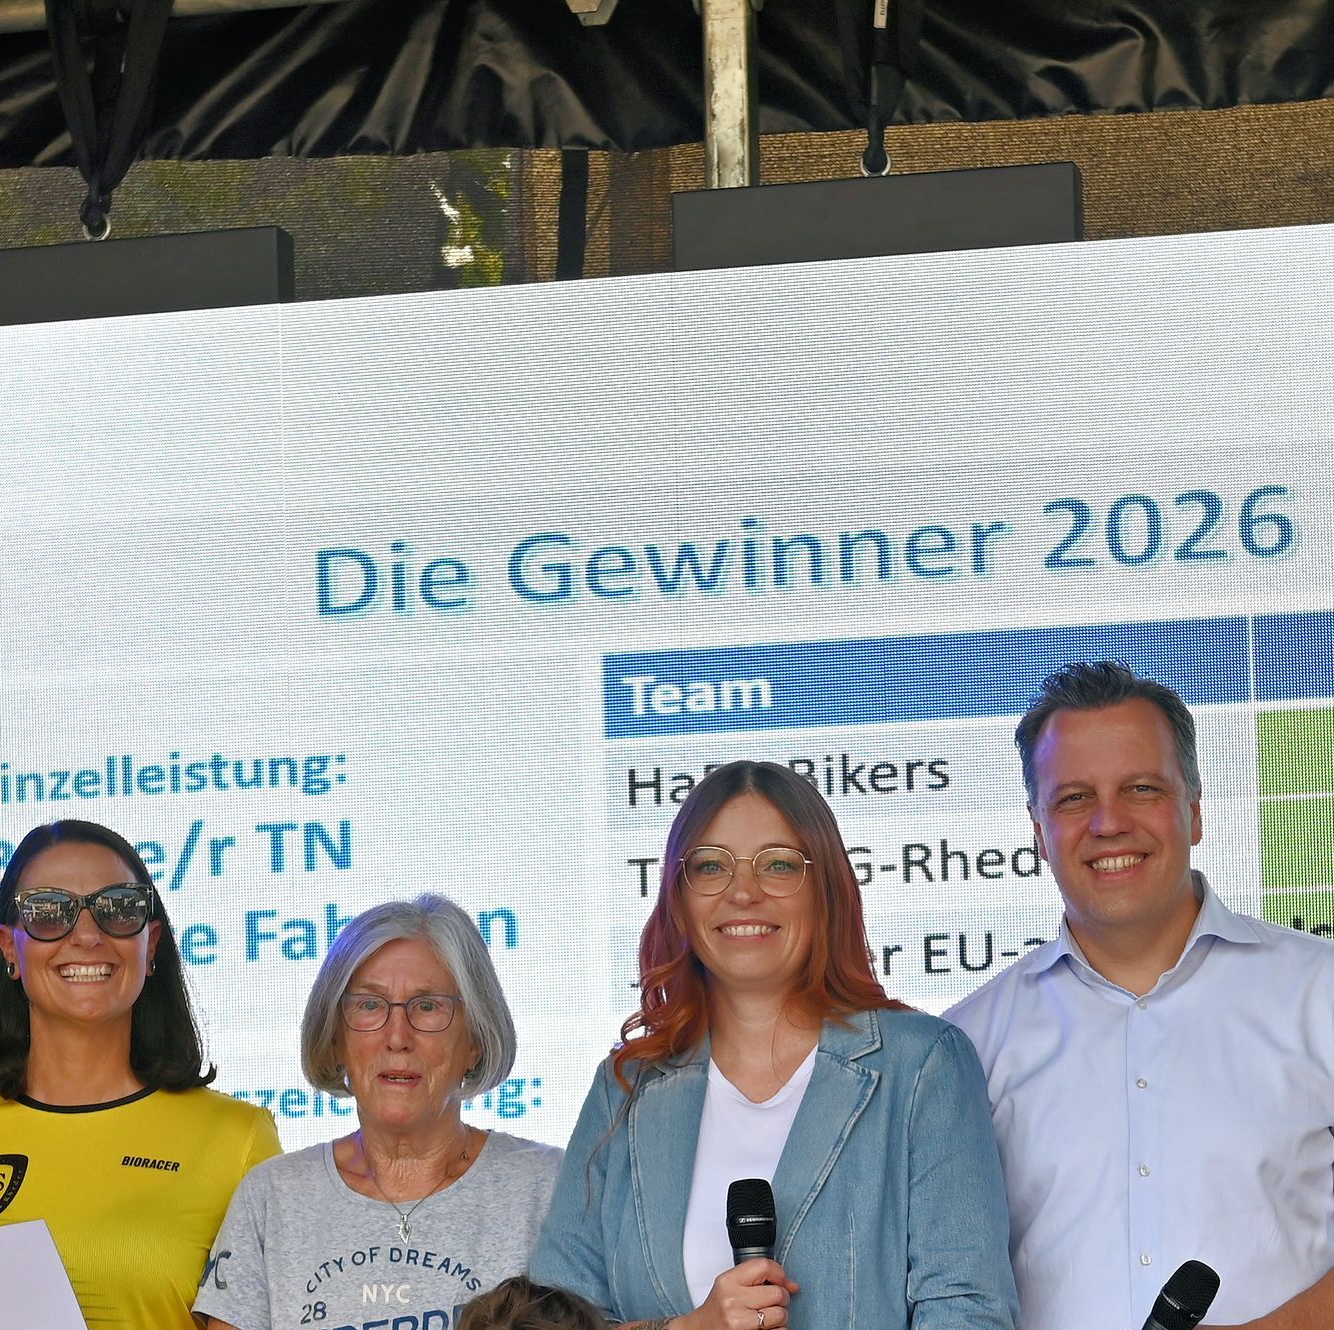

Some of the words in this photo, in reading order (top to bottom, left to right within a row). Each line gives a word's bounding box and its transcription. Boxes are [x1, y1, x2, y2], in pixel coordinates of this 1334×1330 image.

[315, 541, 472, 616] Die
[508, 516, 1012, 605] Gewinner
[1044, 484, 1297, 571] 2026
[622, 675, 770, 716] Team
[255, 819, 352, 872] TN
[121, 1156, 180, 1172] BIORACER
[306, 1256, 344, 1294] CITY
[351, 1246, 381, 1266] OF
[389, 1247, 482, 1292] DREAMS
[300, 1301, 327, 1325] 28
[362, 1284, 411, 1303] NYC
